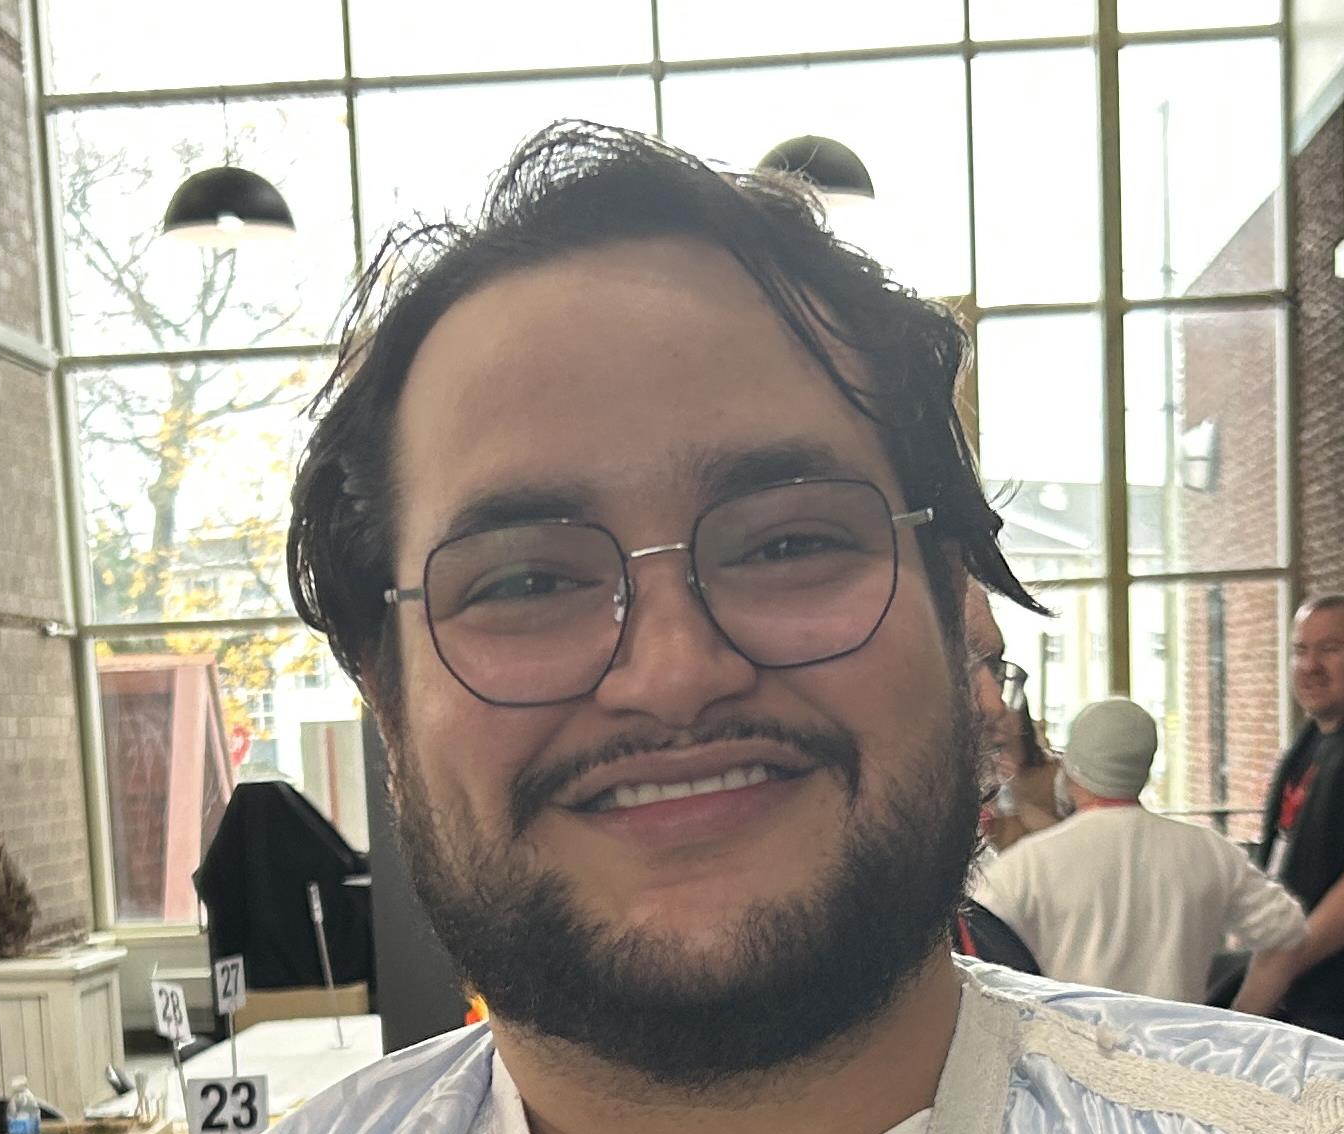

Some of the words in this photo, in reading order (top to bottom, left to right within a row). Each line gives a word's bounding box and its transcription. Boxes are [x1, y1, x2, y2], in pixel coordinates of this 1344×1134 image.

[220, 962, 240, 999] 27
[158, 988, 184, 1026] 28
[200, 1081, 259, 1132] 23
